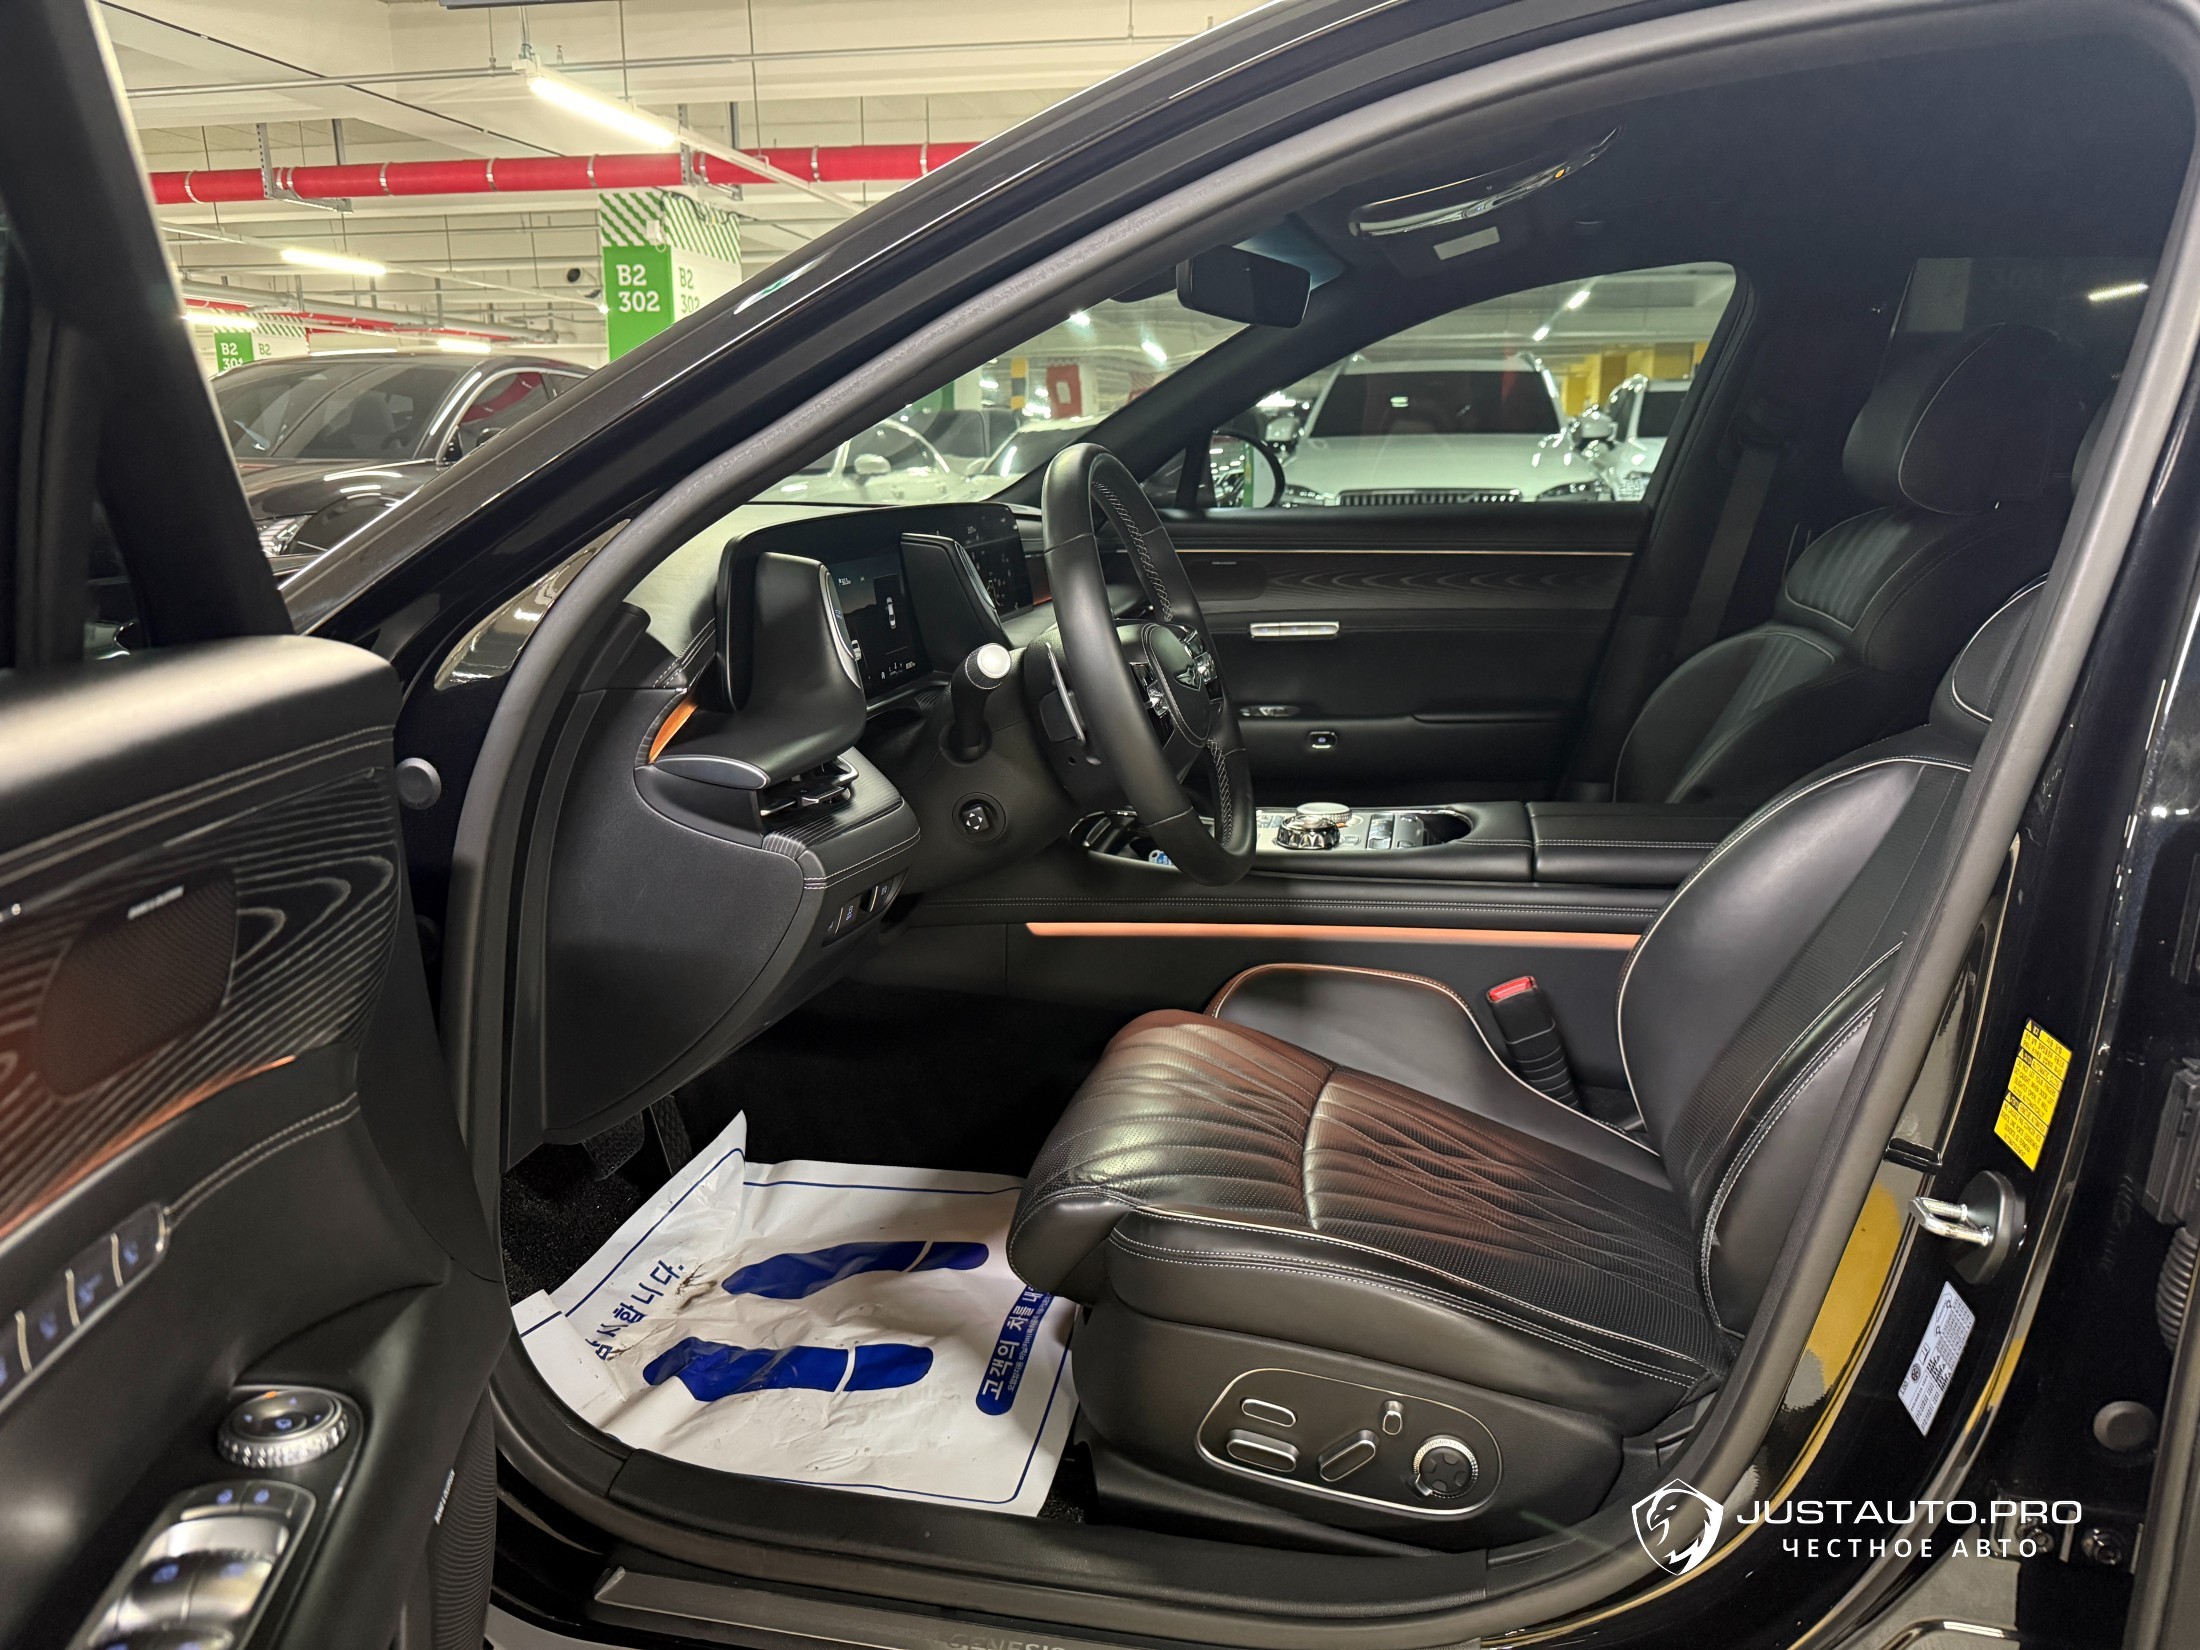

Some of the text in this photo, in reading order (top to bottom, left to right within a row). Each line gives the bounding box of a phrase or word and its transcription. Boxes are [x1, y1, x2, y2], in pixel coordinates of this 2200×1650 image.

[615, 264, 647, 287] B2
[677, 267, 695, 289] B2
[618, 290, 661, 313] 302
[220, 342, 239, 356] B2
[258, 343, 272, 355] B2
[982, 1339, 1021, 1401] 고객의
[1007, 1305, 1036, 1332] 차를
